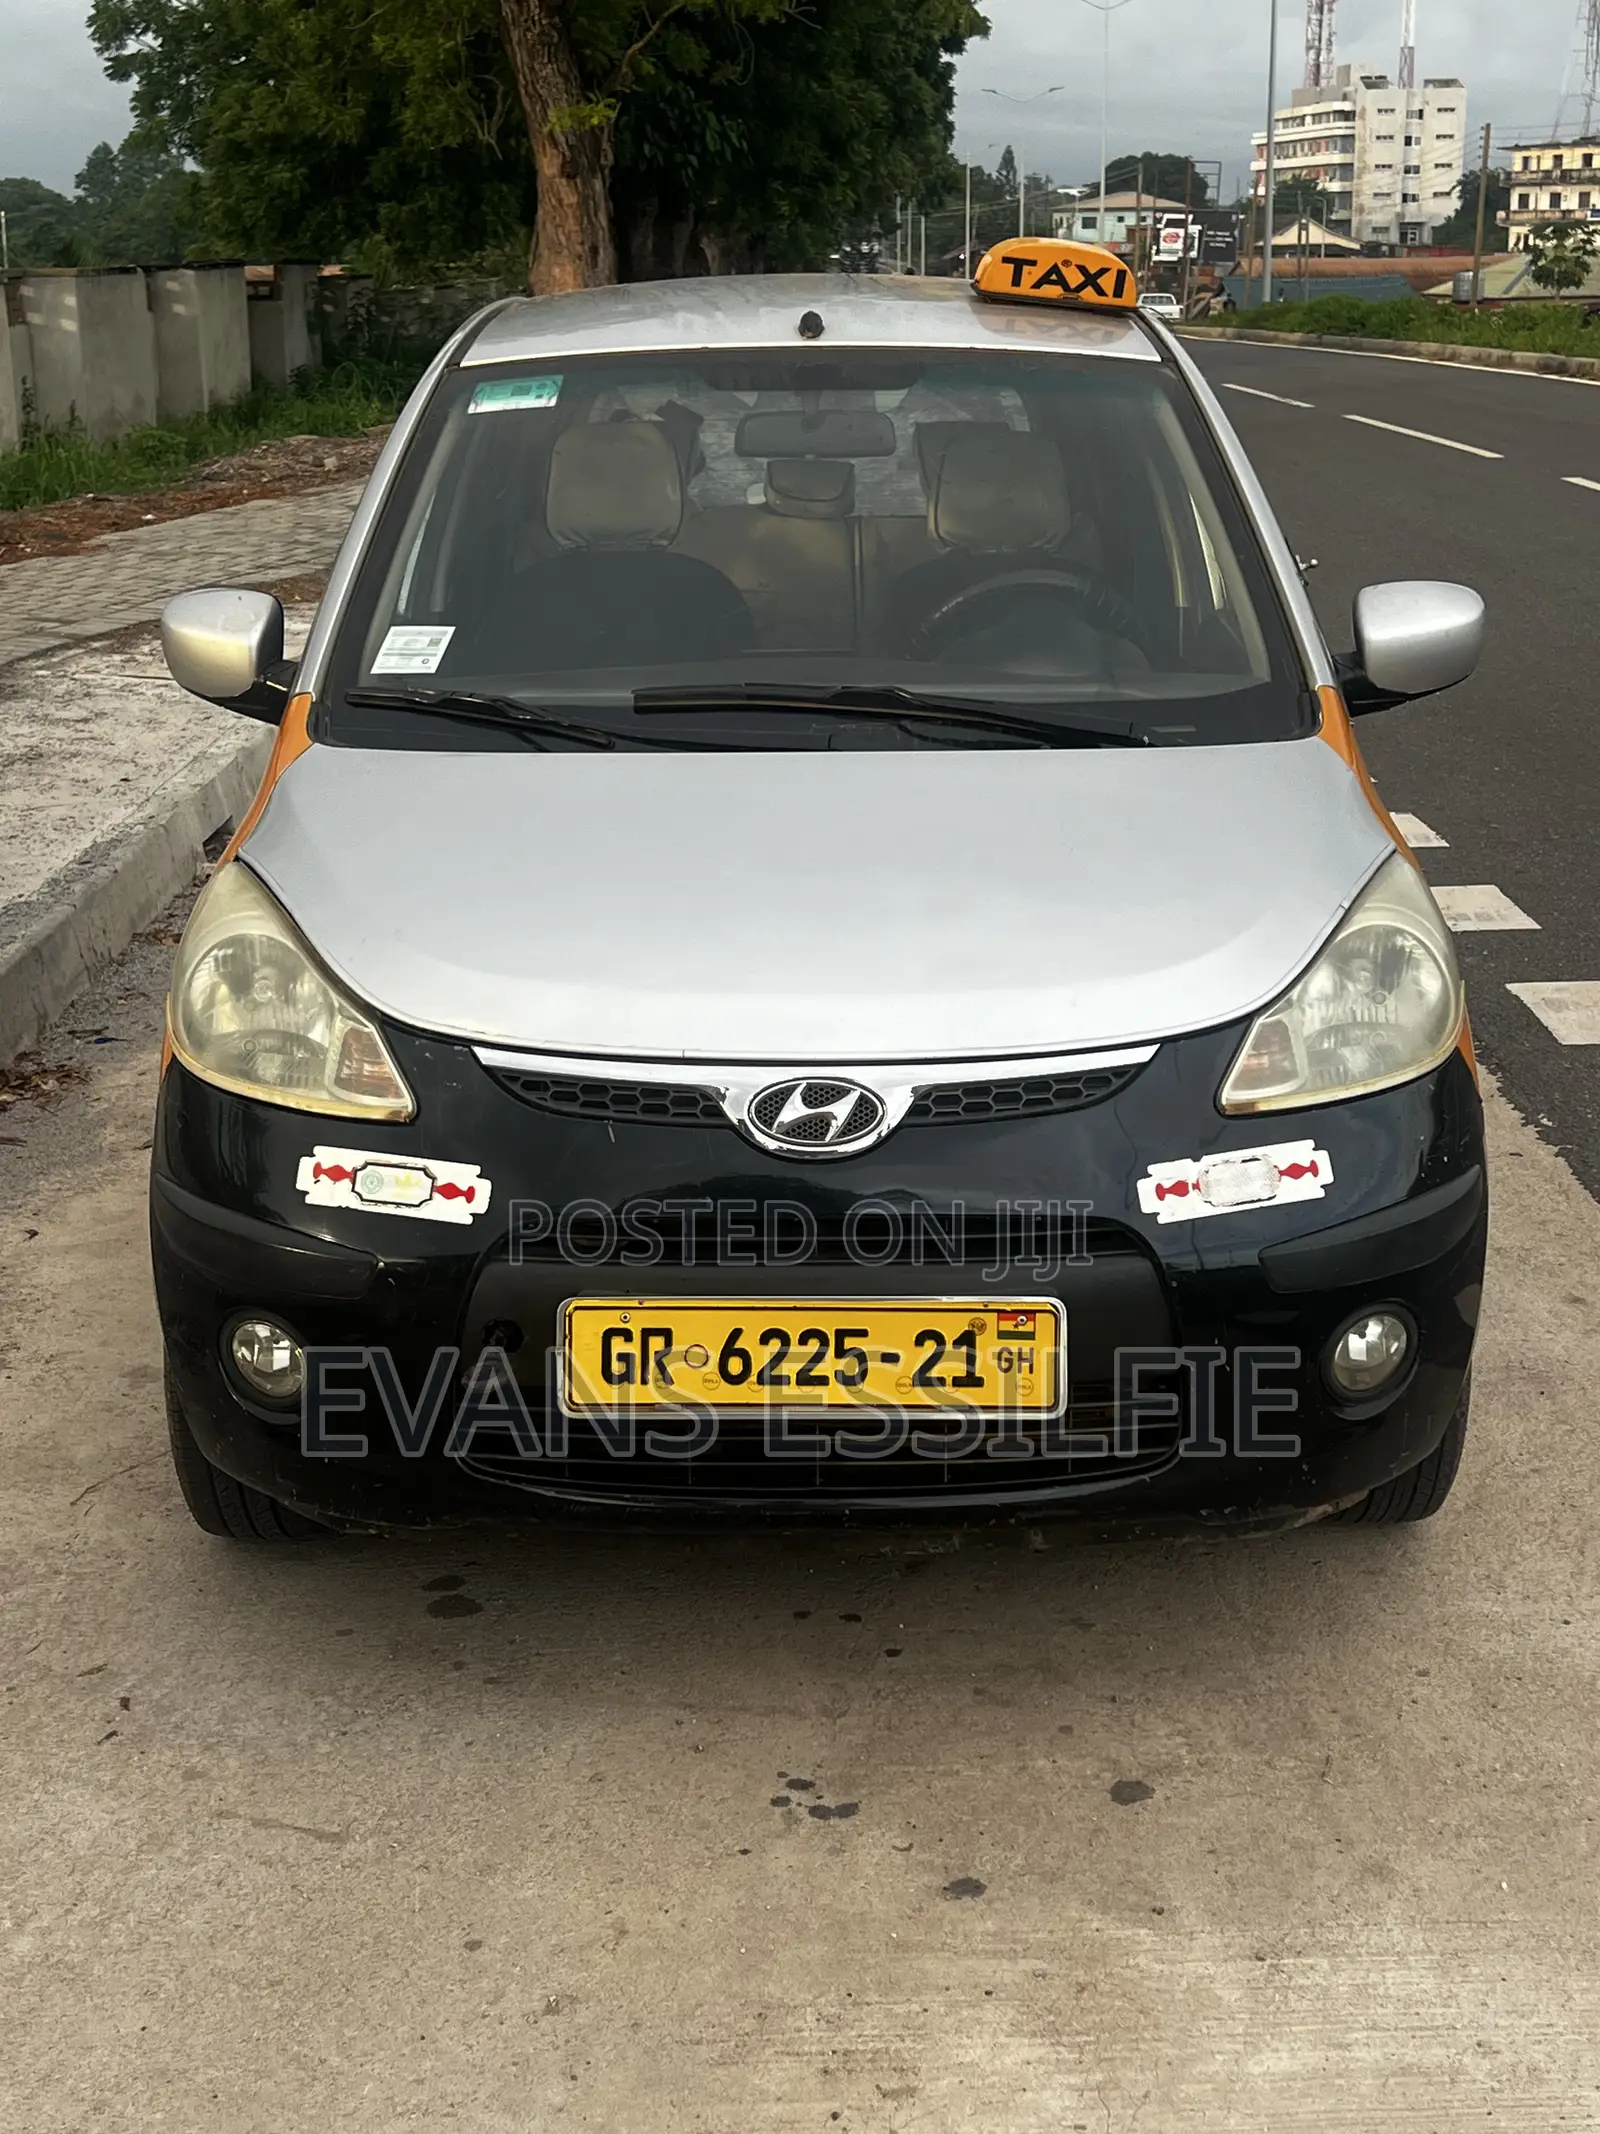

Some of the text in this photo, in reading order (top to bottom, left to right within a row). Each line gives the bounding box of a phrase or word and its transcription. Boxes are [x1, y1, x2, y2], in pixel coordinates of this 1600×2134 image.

[1001, 256, 1127, 298] TAXI
[601, 1327, 675, 1386] GR
[996, 1346, 1035, 1375] GH
